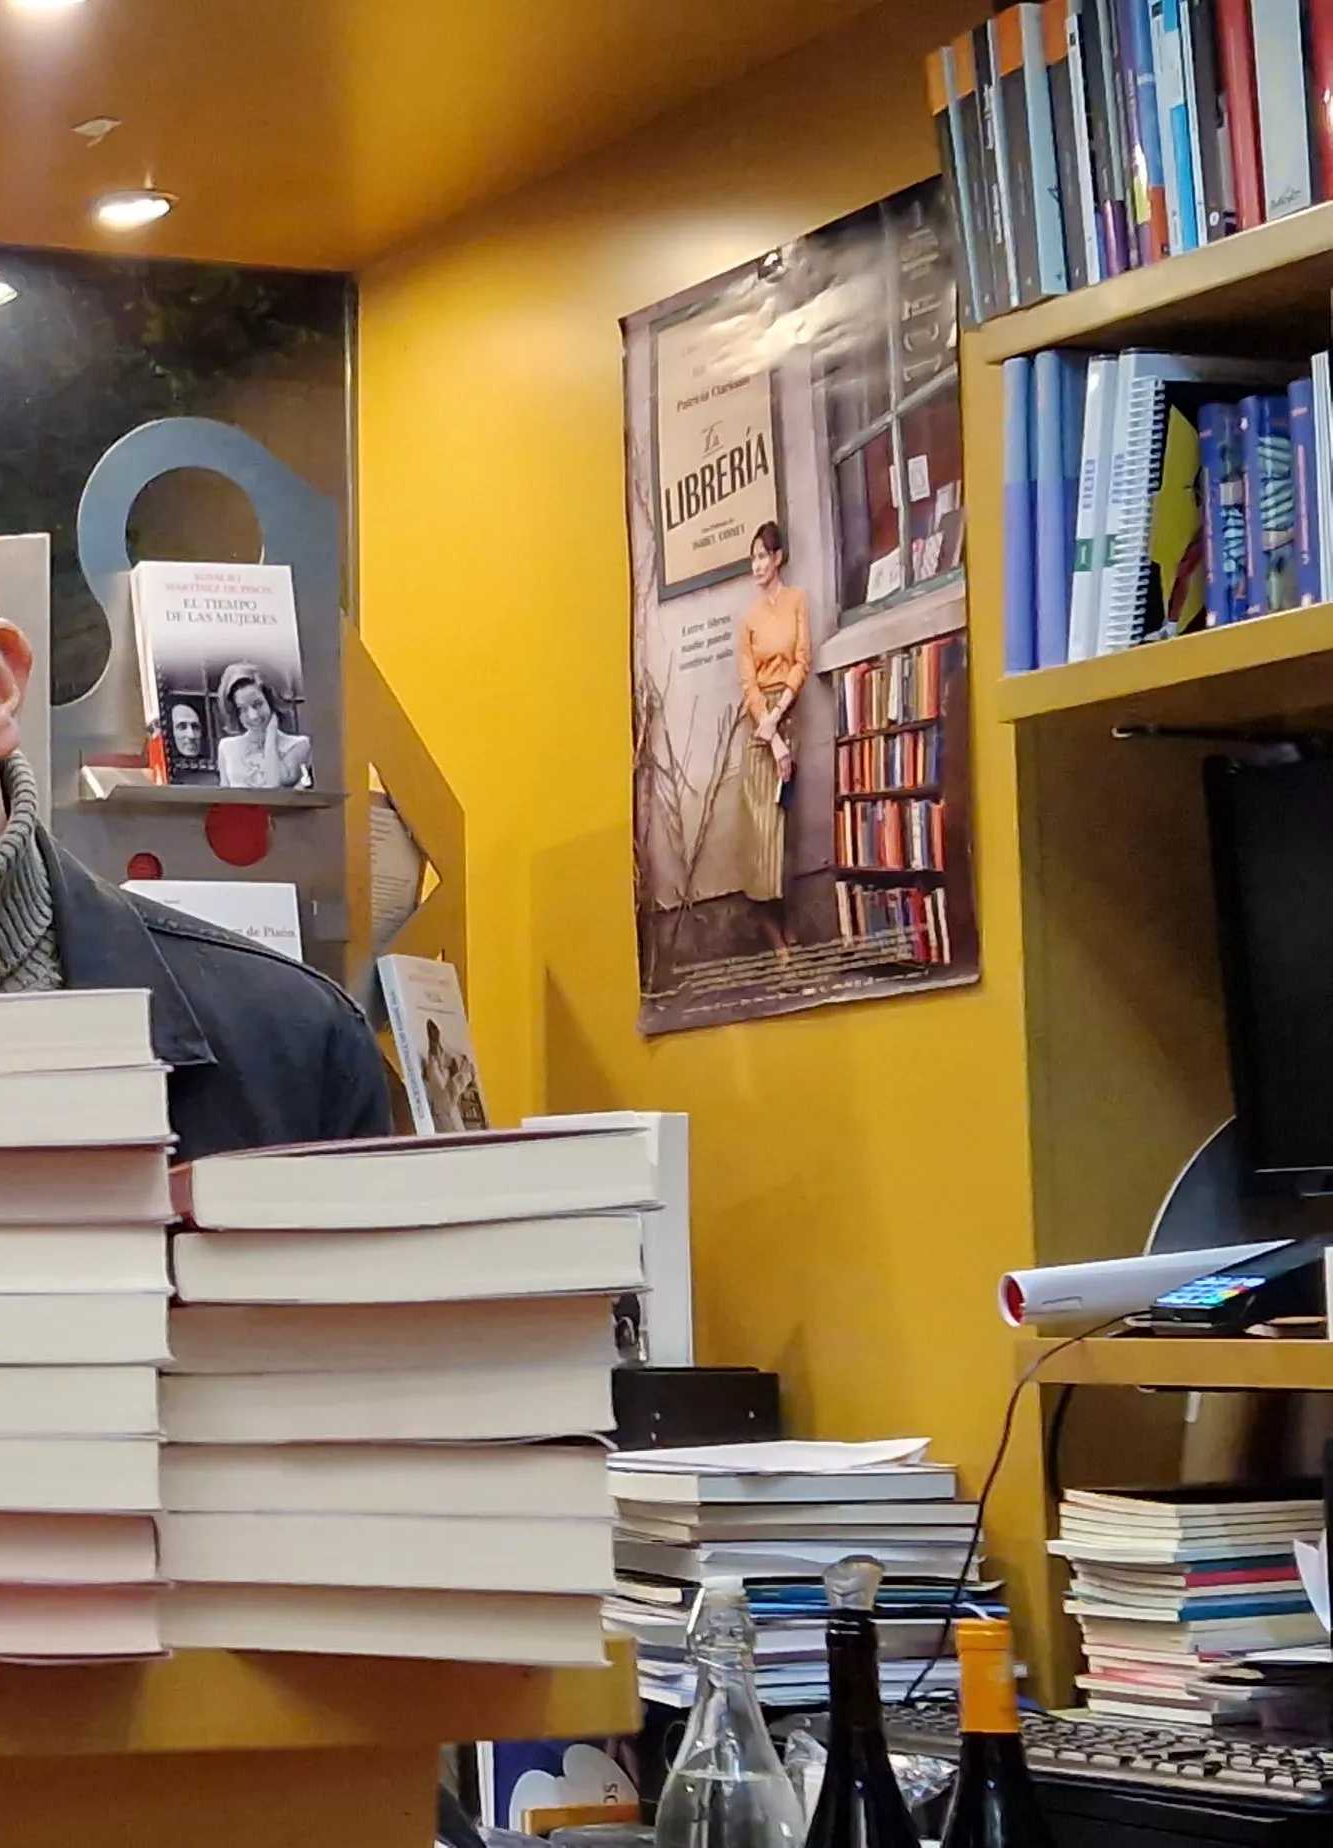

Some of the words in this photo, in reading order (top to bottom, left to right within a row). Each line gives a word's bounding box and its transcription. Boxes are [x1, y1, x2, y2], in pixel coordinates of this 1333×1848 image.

[665, 426, 769, 532] LIBRERÍA
[183, 598, 200, 608] EL
[204, 599, 257, 611] TIEMPO
[166, 610, 181, 622] DE
[188, 611, 213, 623] LAS
[216, 613, 278, 627] MUJERES
[246, 926, 261, 937] de
